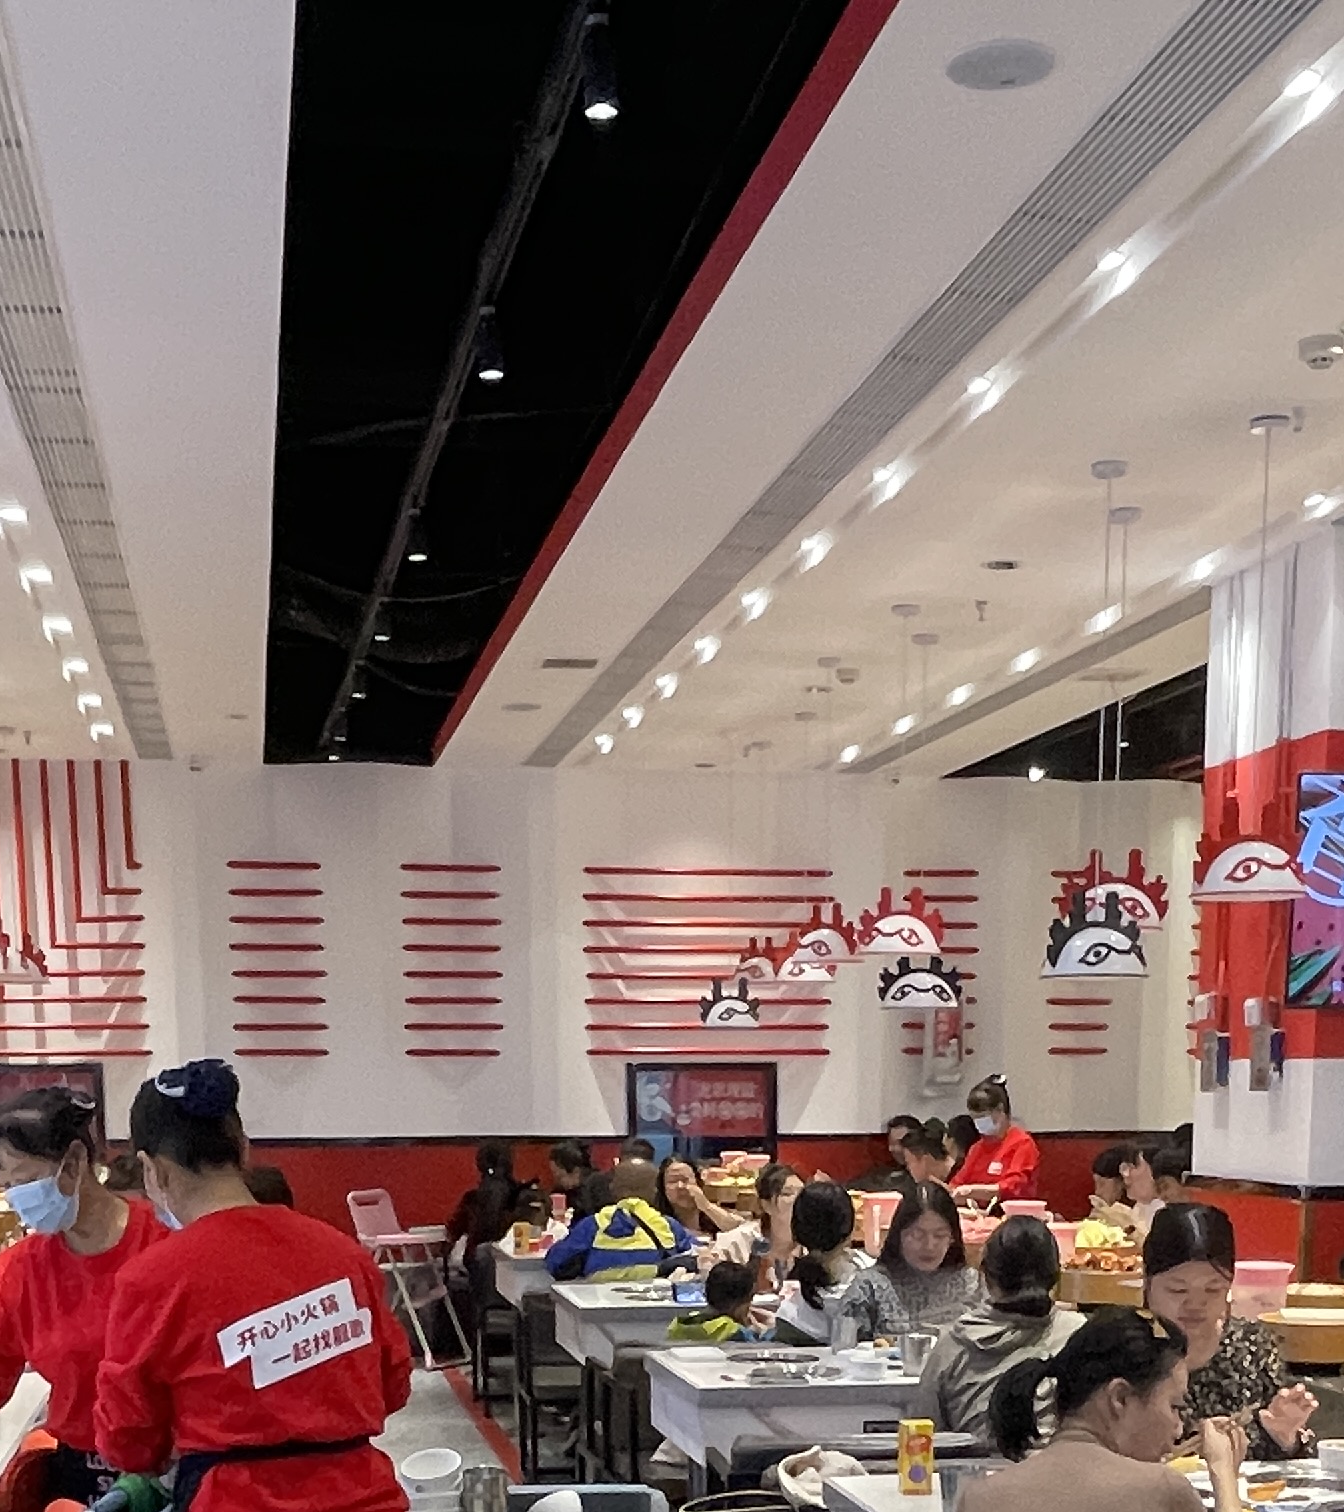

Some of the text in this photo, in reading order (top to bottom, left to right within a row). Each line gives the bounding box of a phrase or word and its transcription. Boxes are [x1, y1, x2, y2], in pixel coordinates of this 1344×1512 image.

[237, 1294, 340, 1353] 开心小火锅
